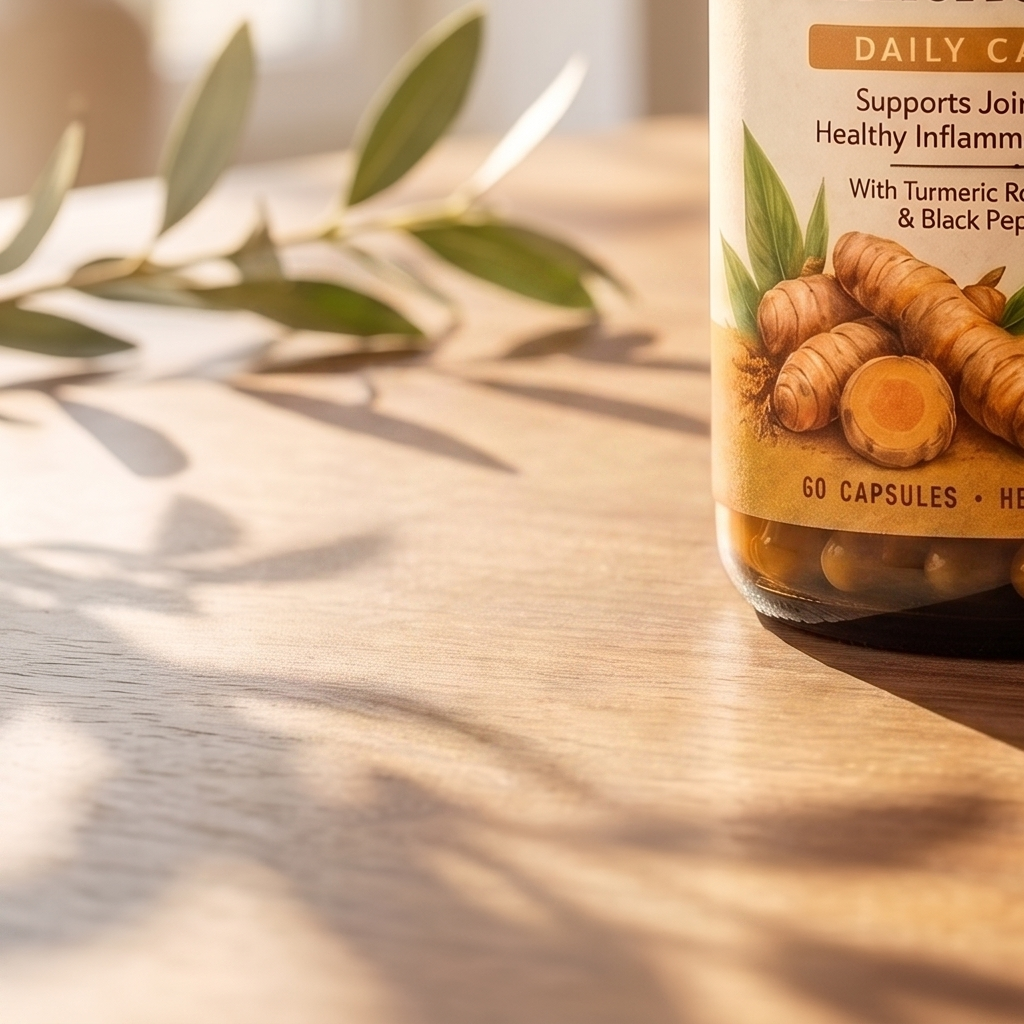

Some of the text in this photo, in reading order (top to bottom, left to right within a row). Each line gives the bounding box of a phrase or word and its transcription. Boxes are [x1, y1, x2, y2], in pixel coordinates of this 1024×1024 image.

[854, 35, 965, 63] DAILY
[856, 87, 972, 121] Supports
[816, 119, 909, 155] Healthy
[849, 177, 897, 200] With
[903, 180, 999, 203] Turmeric
[897, 207, 915, 229] &
[922, 207, 981, 231] Black
[802, 475, 827, 500] 60
[840, 480, 958, 509] CAPSULES
